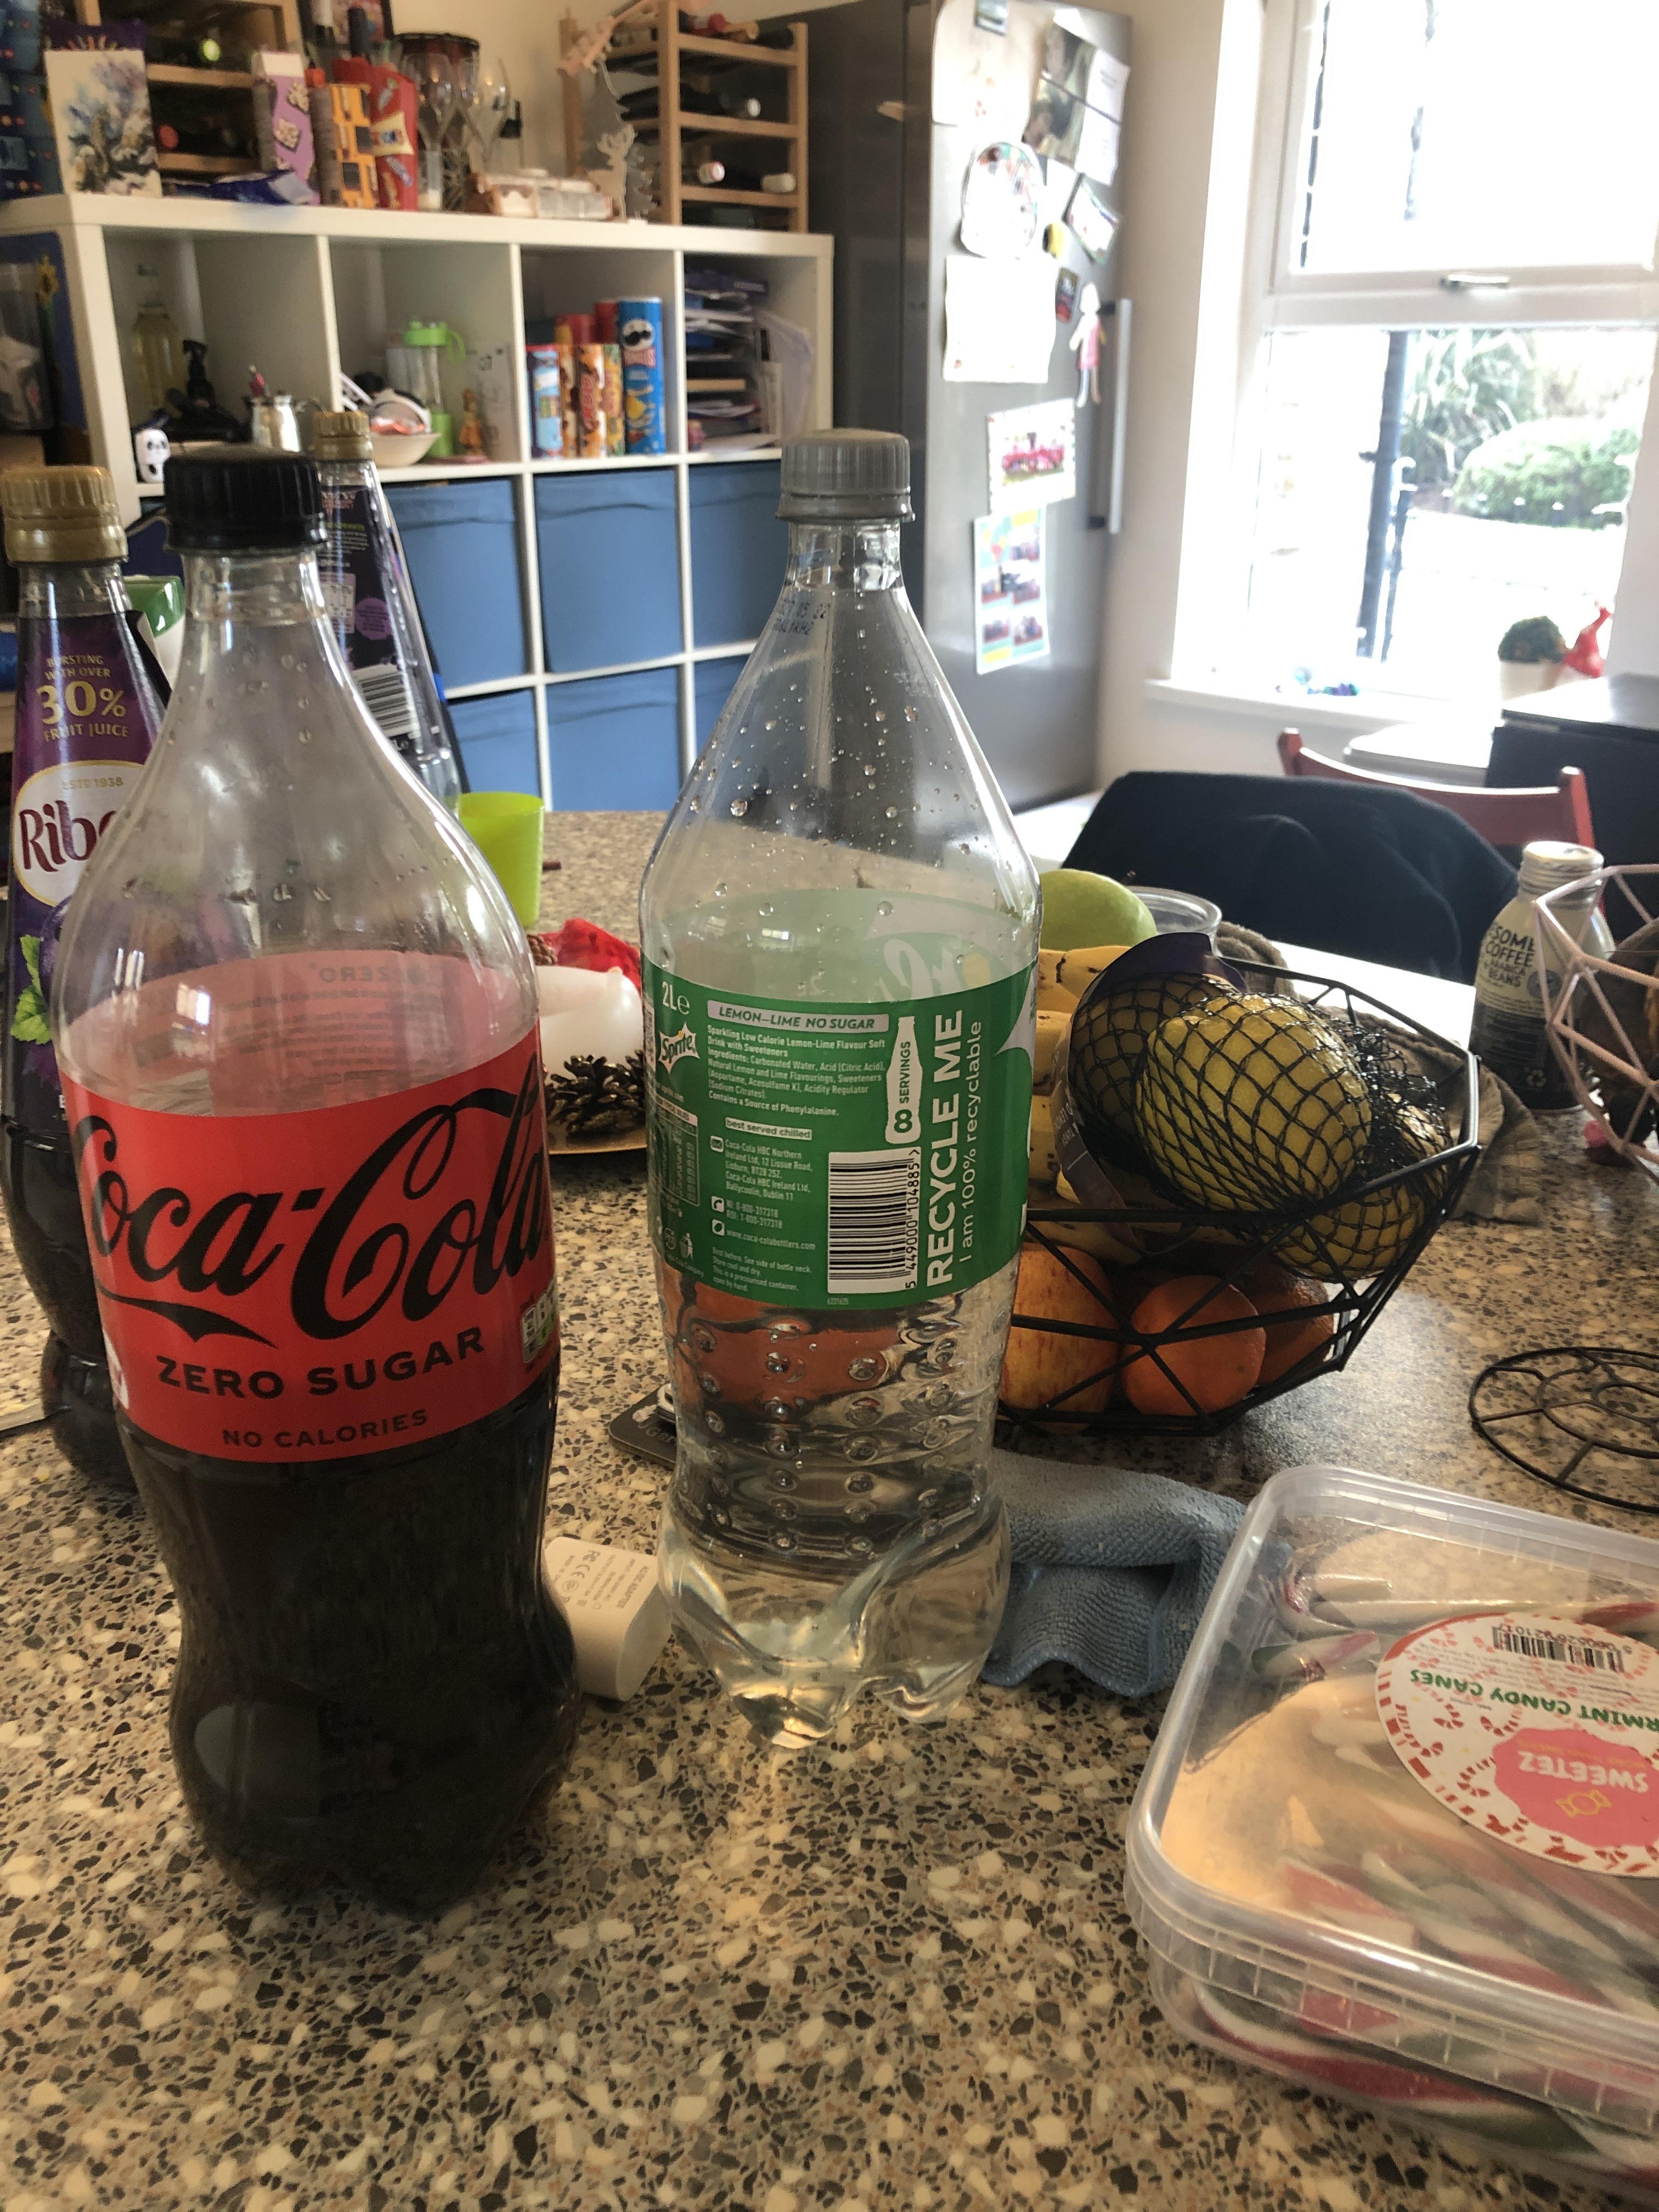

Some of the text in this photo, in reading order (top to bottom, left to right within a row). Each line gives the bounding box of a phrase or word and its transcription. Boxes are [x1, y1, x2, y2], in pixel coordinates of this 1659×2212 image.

[80, 667, 110, 678] OVER
[36, 681, 126, 724] 30%
[43, 723, 129, 742] FRUIT JUICE
[94, 776, 123, 788] 1938
[1486, 940, 1535, 967] COFFEE
[707, 1024, 885, 1049] Sparkling Low Calorie Lemon-Lime Flavour Soft
[806, 1018, 827, 1028] NO
[830, 1018, 875, 1029] SUGAR
[662, 1034, 693, 1063] Sprite
[708, 1035, 788, 1057] Drink with Sweeteners
[708, 1058, 732, 1070] Natural
[733, 1063, 755, 1075] Lemon
[757, 1069, 769, 1077] and
[771, 1069, 788, 1079] Lime
[838, 1074, 882, 1083] Sweeteners
[751, 1055, 791, 1068] Carbonated
[820, 1062, 837, 1071] Acid
[749, 1077, 790, 1090] Acesulfame
[804, 1084, 830, 1095] Acidity
[832, 1085, 868, 1096] Regulator
[894, 1041, 913, 1133] 8 SERVINGS
[965, 1021, 982, 1140] recyclable
[708, 1090, 737, 1105] Contains
[744, 1098, 770, 1110] Source
[726, 1119, 810, 1138] best served chilled
[725, 1139, 755, 1153] Coca-Cola
[772, 1148, 802, 1159] Northern
[762, 1158, 769, 1166] 12
[927, 1010, 962, 1287] RECYCLE ME
[725, 1171, 755, 1185] Coca-Cola
[772, 1180, 795, 1191] Ireland
[907, 1163, 919, 1213] 104885
[961, 1148, 977, 1208] 100%
[72, 1054, 549, 1347] Coca-Cola
[961, 1212, 973, 1248] am
[905, 1220, 918, 1271] 449000
[157, 1355, 283, 1399] ZERO
[308, 1327, 485, 1396] SUGAR
[223, 1408, 427, 1449] NO CALORIES
[1410, 1669, 1483, 1696] CANES
[1490, 1687, 1571, 1715] CANDY
[1518, 1750, 1650, 1793] SWEETEZ
